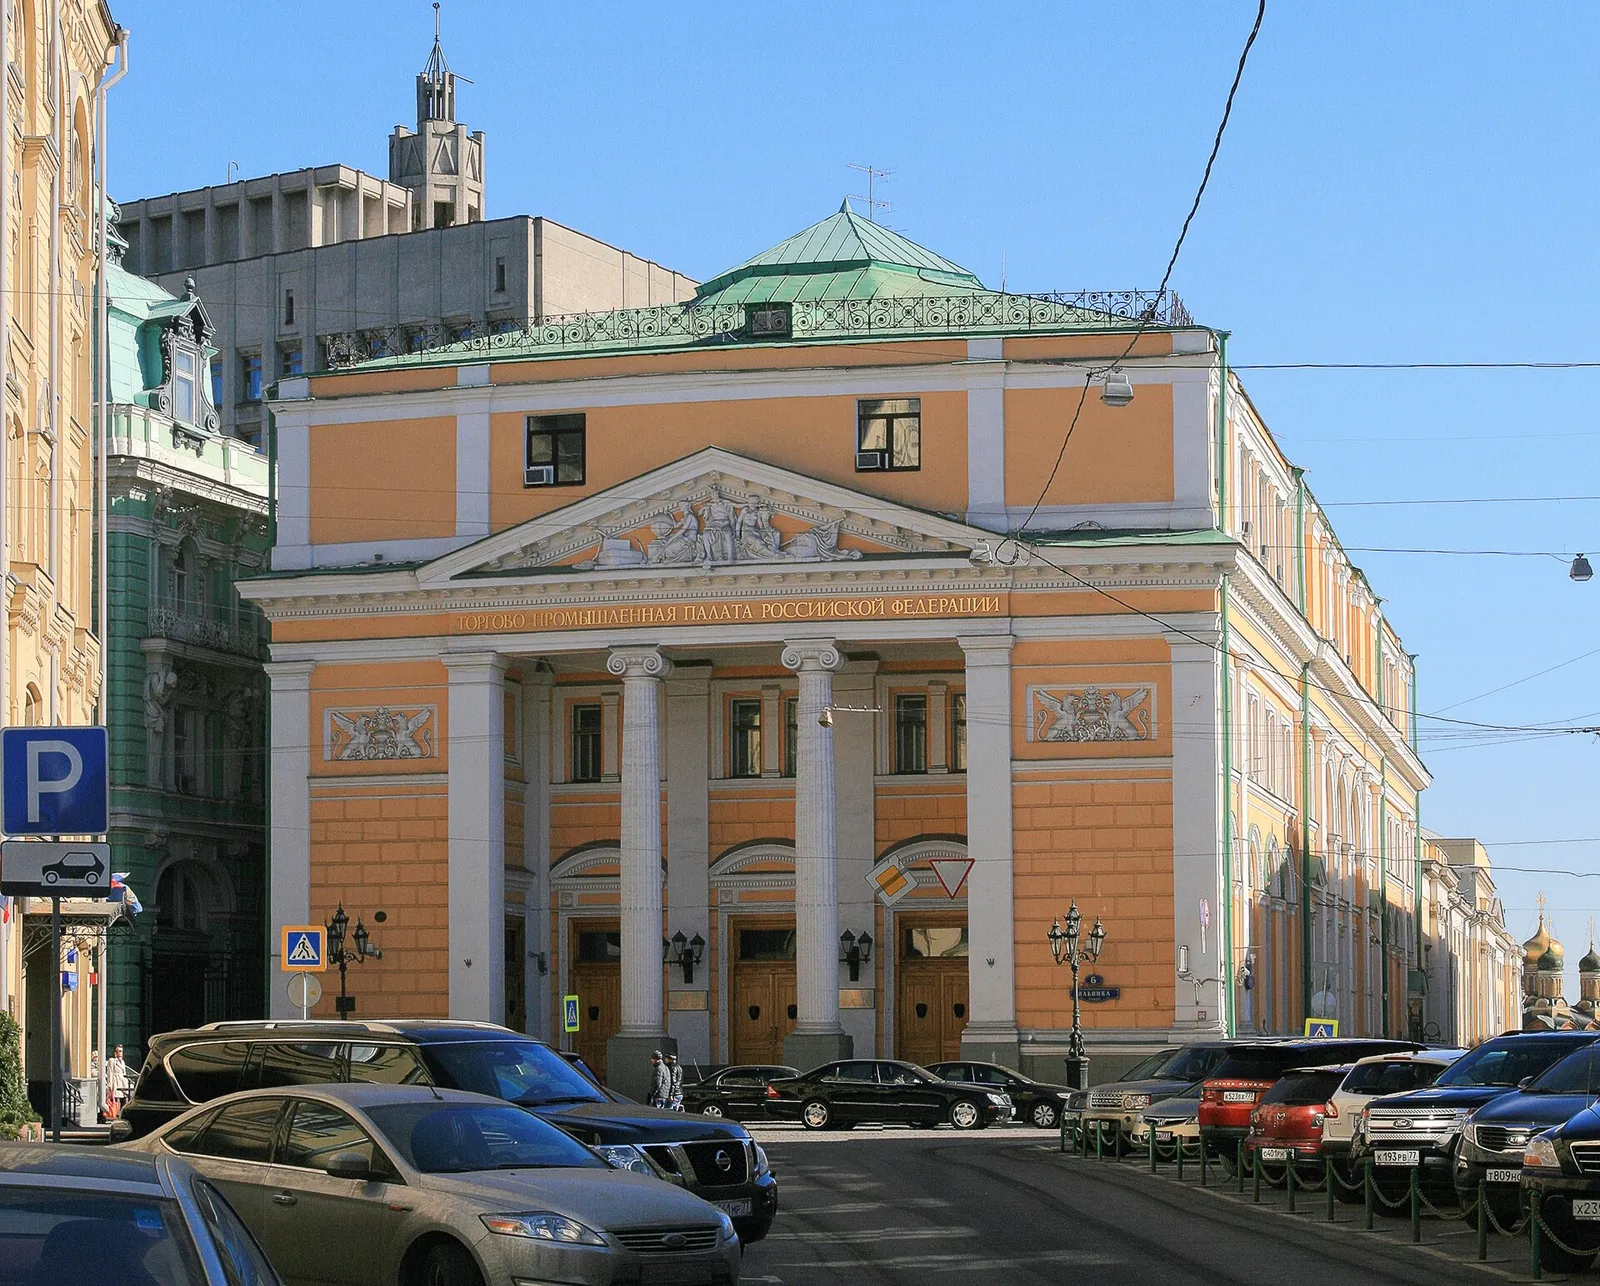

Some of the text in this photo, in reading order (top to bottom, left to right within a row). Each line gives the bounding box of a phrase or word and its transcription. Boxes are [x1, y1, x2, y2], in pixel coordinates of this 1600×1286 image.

[684, 603, 753, 621] ПАЛАТА
[761, 598, 886, 619] РОССИЙСКОЙ
[891, 596, 1001, 616] ФЕДЕРАЦИИ
[27, 740, 83, 823] P
[1576, 1202, 1600, 1214] Х23
